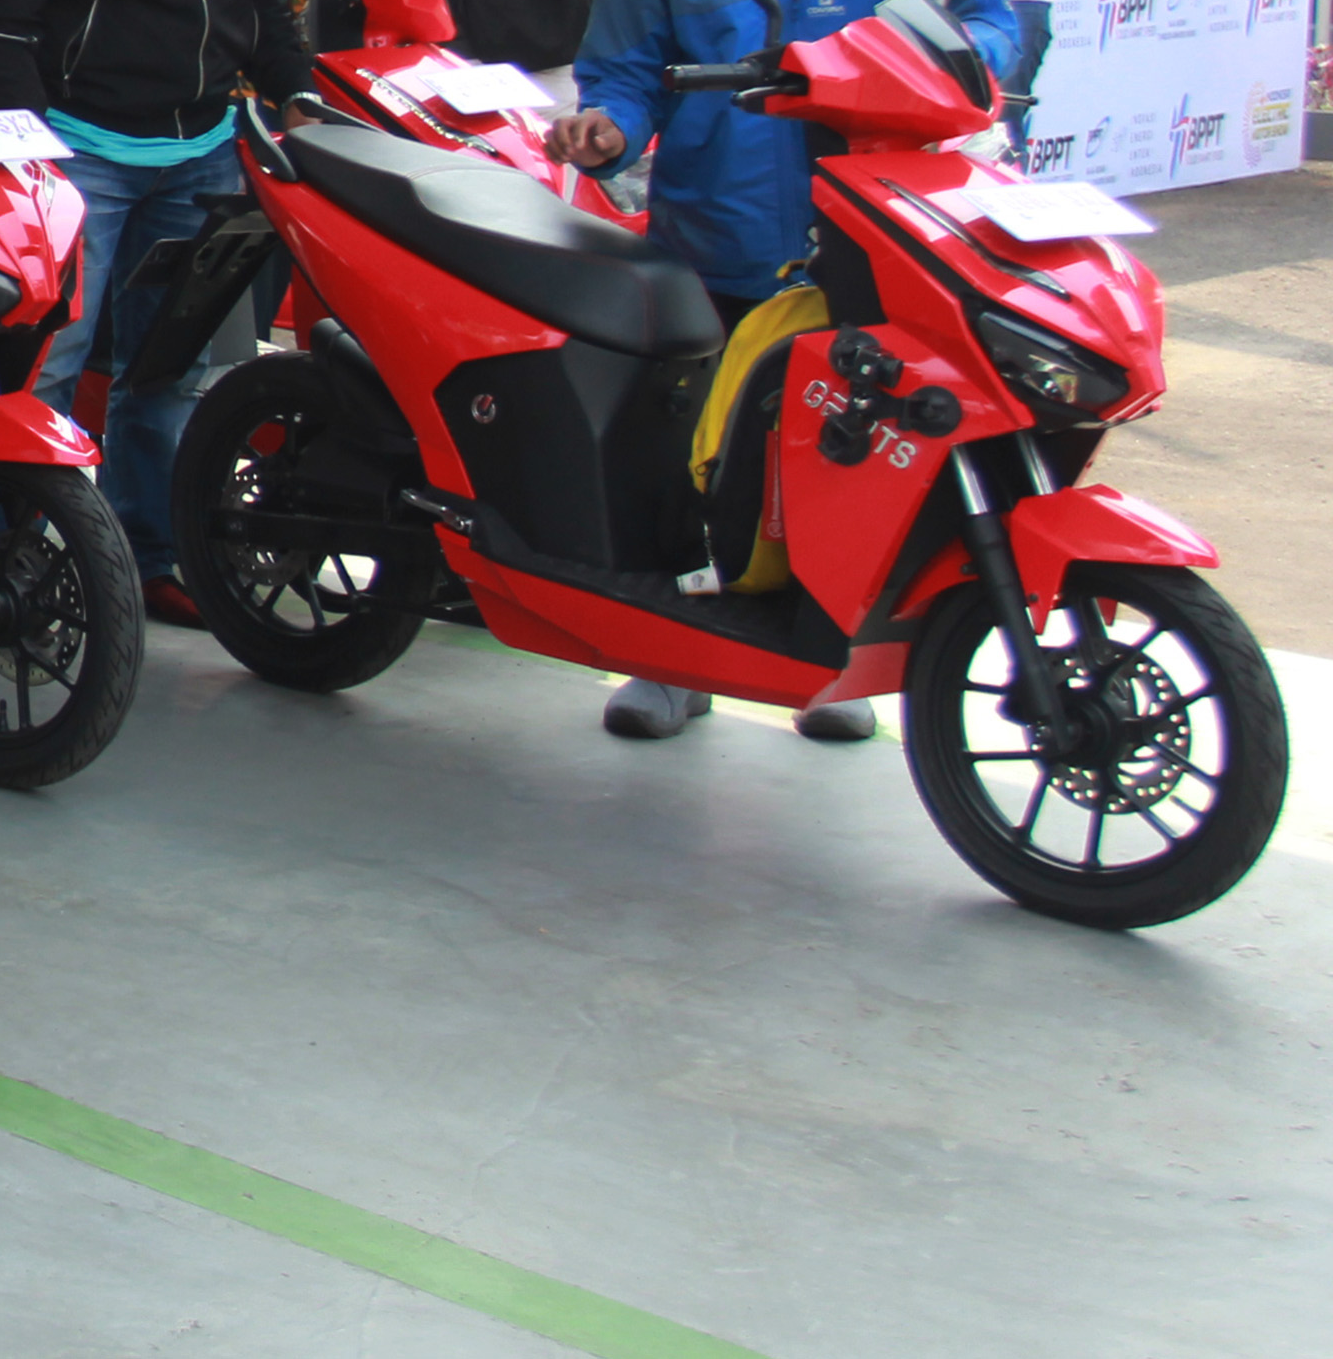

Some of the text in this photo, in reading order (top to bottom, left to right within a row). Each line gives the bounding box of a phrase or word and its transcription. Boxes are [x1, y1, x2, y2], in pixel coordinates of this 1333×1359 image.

[1187, 113, 1226, 152] BPPT
[1031, 135, 1076, 175] BPPT
[803, 379, 918, 469] GEITS
